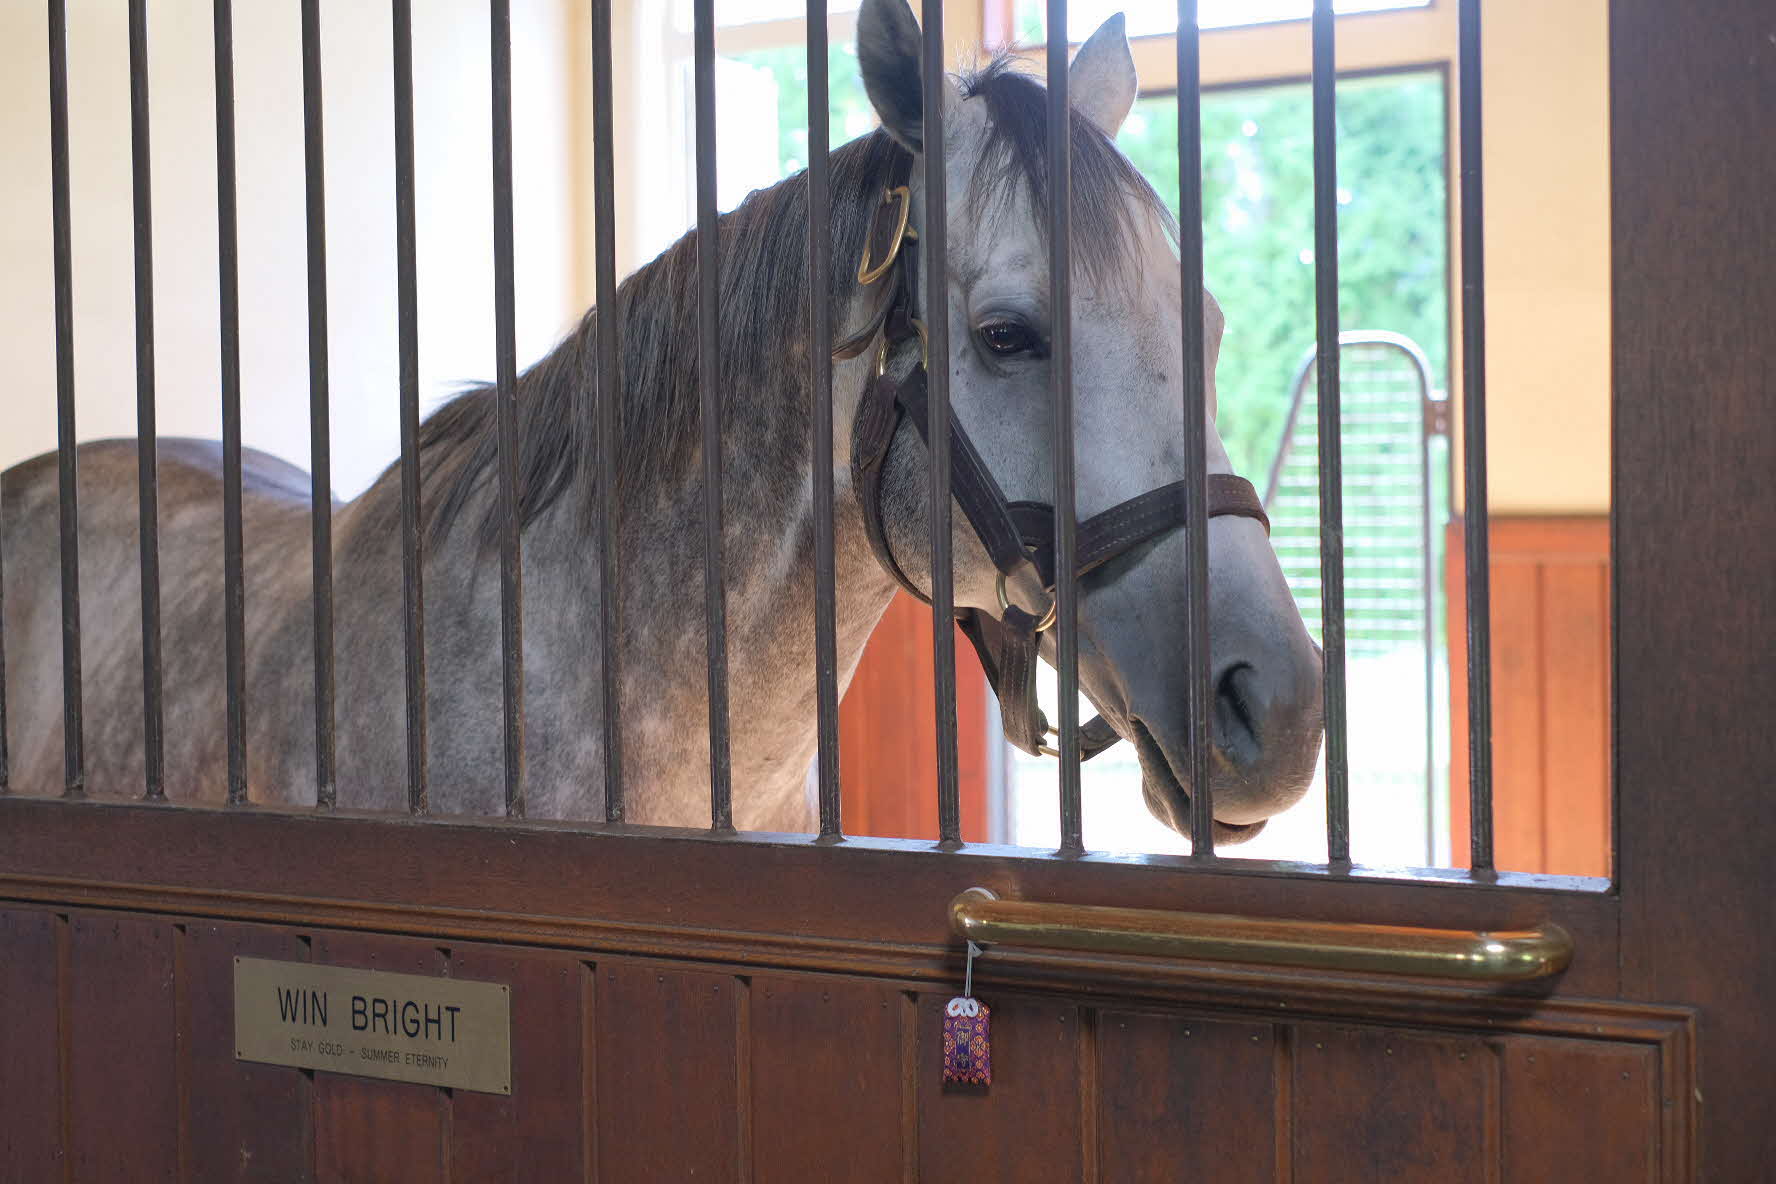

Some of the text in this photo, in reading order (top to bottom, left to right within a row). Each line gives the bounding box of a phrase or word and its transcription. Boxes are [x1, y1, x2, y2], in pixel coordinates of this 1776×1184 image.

[277, 986, 461, 1043] WIN BRIGHT
[290, 1037, 313, 1053] STAY
[318, 1041, 343, 1057] GOLD
[360, 1047, 401, 1064] SUMMER
[405, 1052, 449, 1070] ETERNITY
